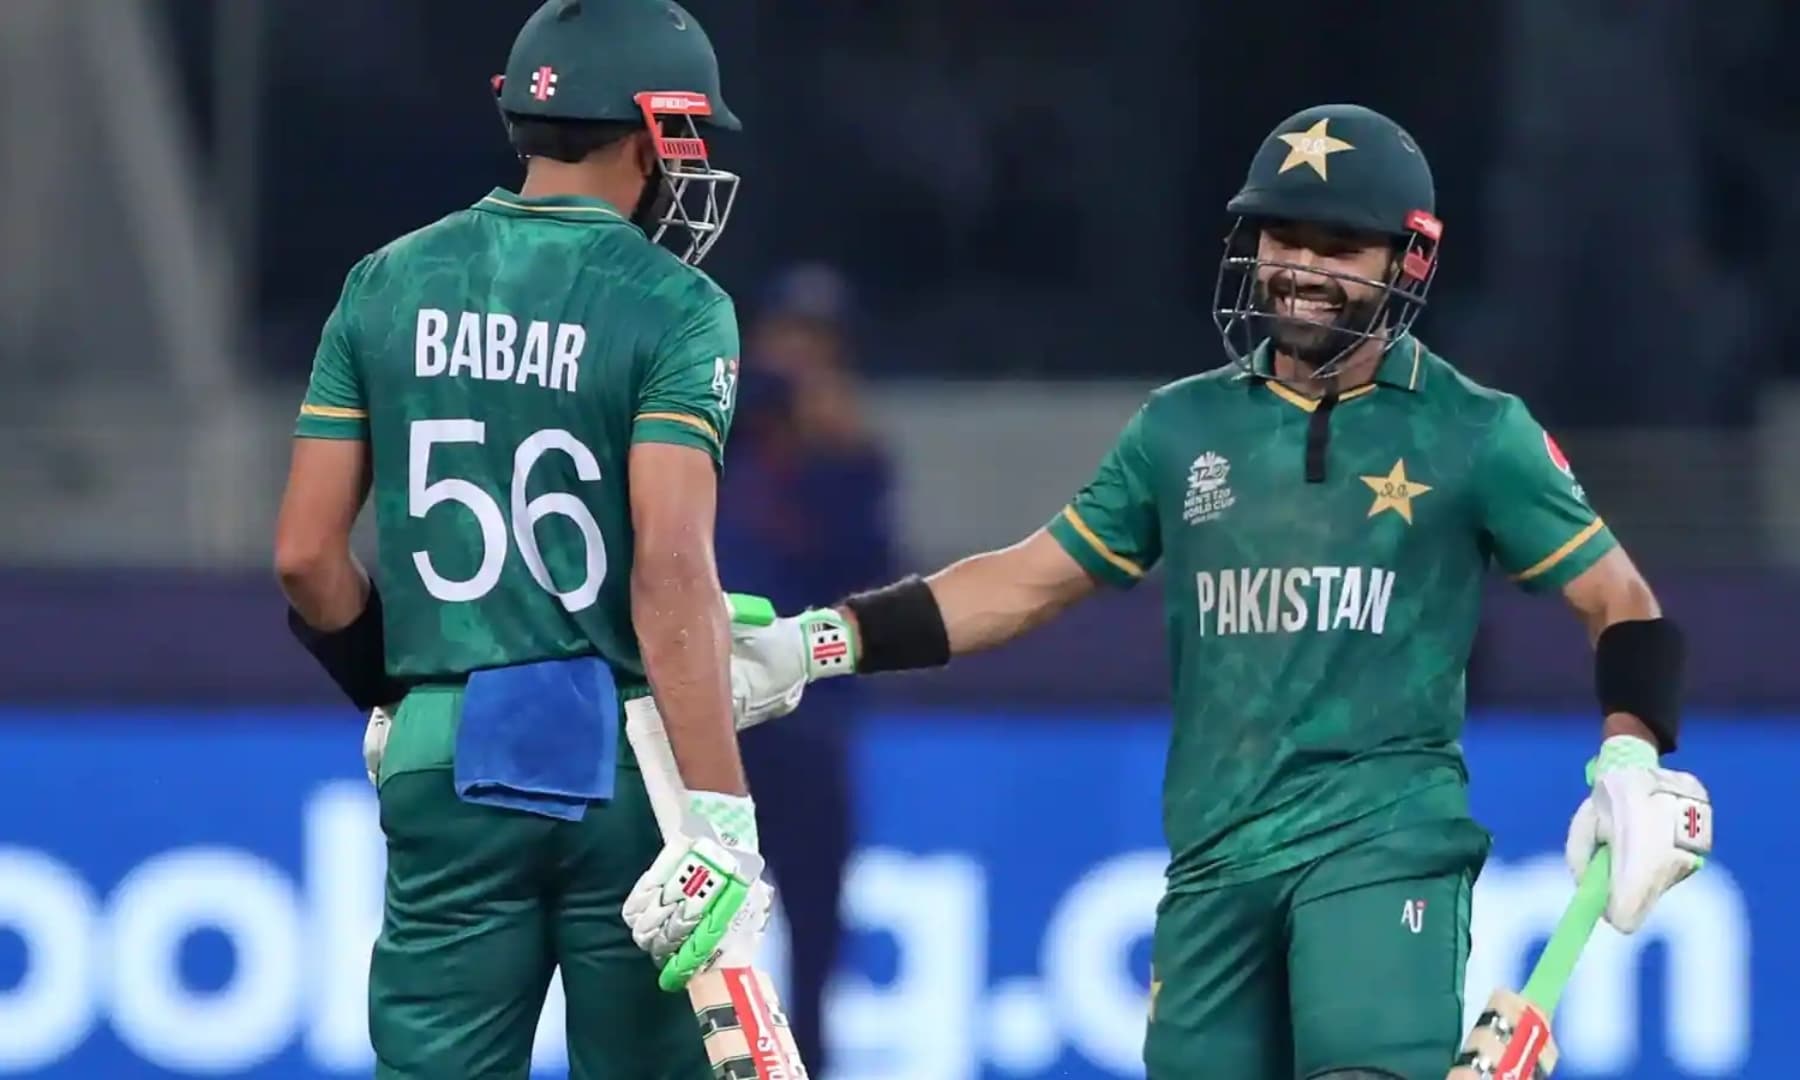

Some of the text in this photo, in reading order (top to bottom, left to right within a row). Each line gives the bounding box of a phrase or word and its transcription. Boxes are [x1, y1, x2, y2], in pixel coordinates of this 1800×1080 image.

[415, 308, 586, 392] BABAR
[409, 418, 608, 612] 56
[1183, 504, 1213, 521] WORLD
[1213, 496, 1237, 510] CUP
[1196, 566, 1396, 637] PAKISTAN
